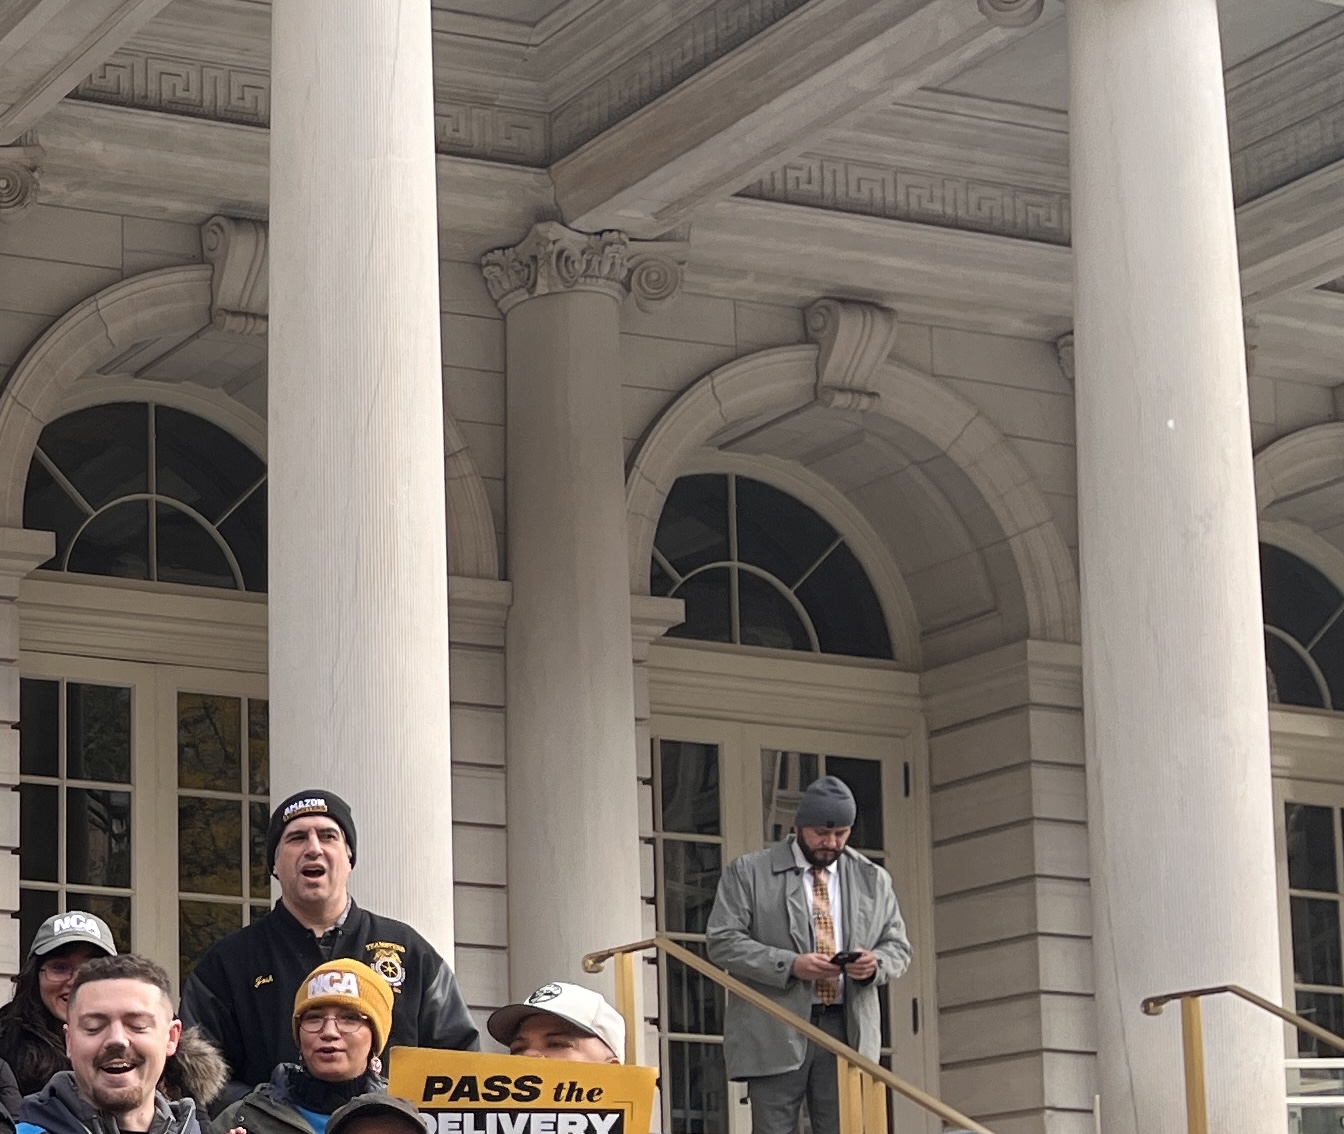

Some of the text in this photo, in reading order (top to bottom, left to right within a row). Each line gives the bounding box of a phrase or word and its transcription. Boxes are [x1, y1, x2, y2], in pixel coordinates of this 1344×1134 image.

[284, 798, 326, 816] AMAZON
[53, 914, 101, 940] NCA
[307, 971, 360, 1000] NCA
[422, 1075, 604, 1102] PASS the
